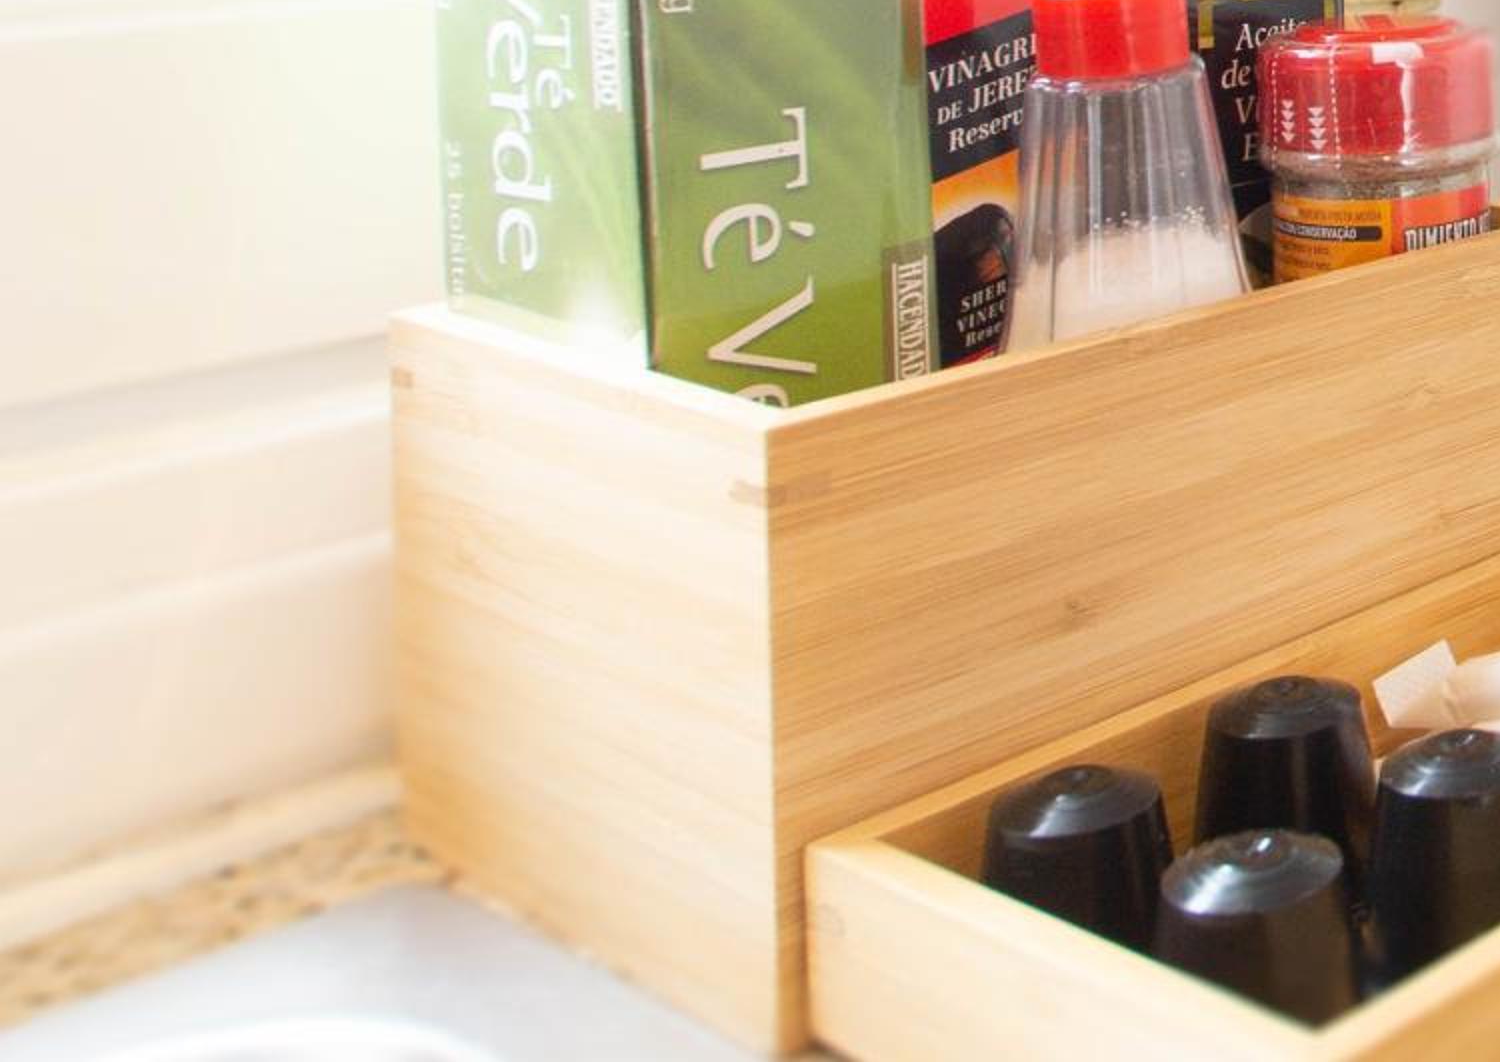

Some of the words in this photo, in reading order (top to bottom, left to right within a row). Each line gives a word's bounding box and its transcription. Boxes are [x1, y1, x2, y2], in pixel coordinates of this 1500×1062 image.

[1235, 18, 1307, 52] Aceit
[533, 14, 575, 109] Té
[1221, 60, 1250, 89] de
[937, 100, 962, 125] DE
[949, 109, 1023, 153] Reserv
[700, 106, 816, 271] Té
[961, 280, 1007, 313] SHER
[898, 260, 925, 381] HACENDAD
